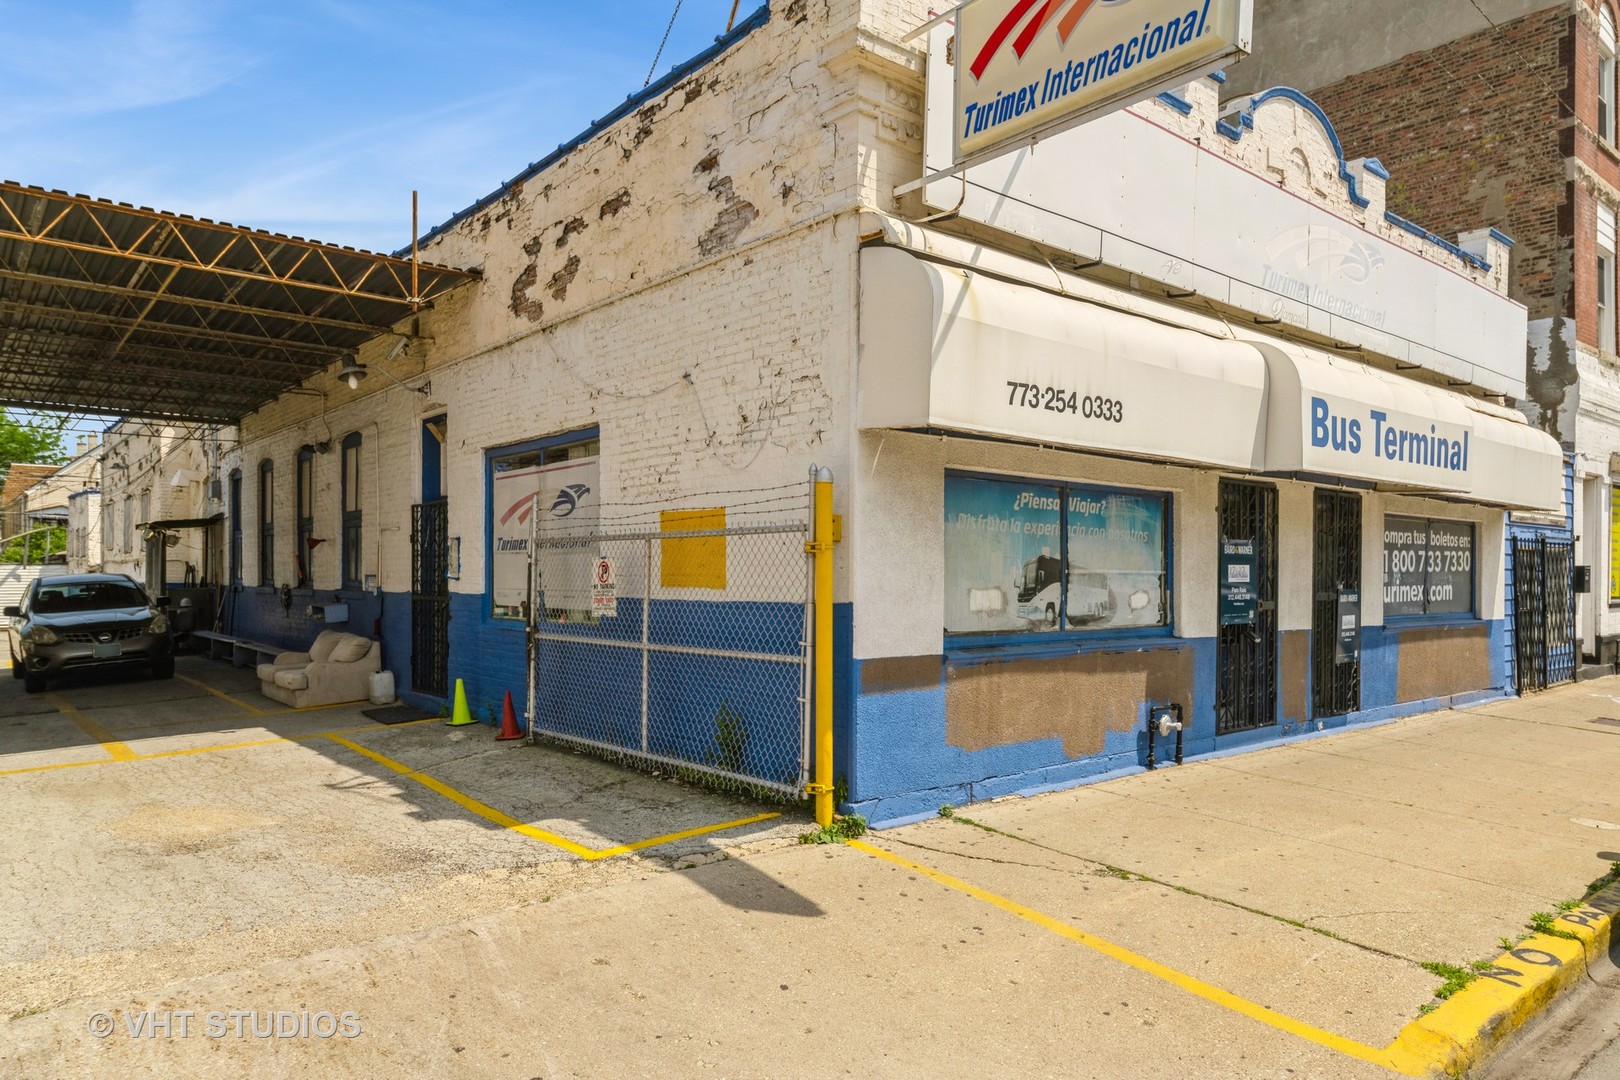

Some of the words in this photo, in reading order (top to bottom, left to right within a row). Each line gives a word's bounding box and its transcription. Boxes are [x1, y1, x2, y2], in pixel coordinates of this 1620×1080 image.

[964, 81, 1040, 139] Turimex
[1040, 0, 1210, 104] Internacional
[1261, 263, 1310, 301] Turimex
[1313, 284, 1387, 328] Internacional
[1082, 395, 1123, 423] 0333
[1311, 397, 1361, 454] Bus
[1370, 409, 1469, 471] Terminal
[1010, 517, 1022, 533] la
[1088, 526, 1105, 539] con
[1384, 530, 1412, 547] ompra
[1414, 530, 1426, 544] tus
[1430, 530, 1458, 547] boletos
[1459, 535, 1471, 548] en:
[497, 537, 528, 551] Turimex
[1392, 550, 1416, 572] 800
[1444, 550, 1471, 572] 7330
[1478, 948, 1562, 988] NO
